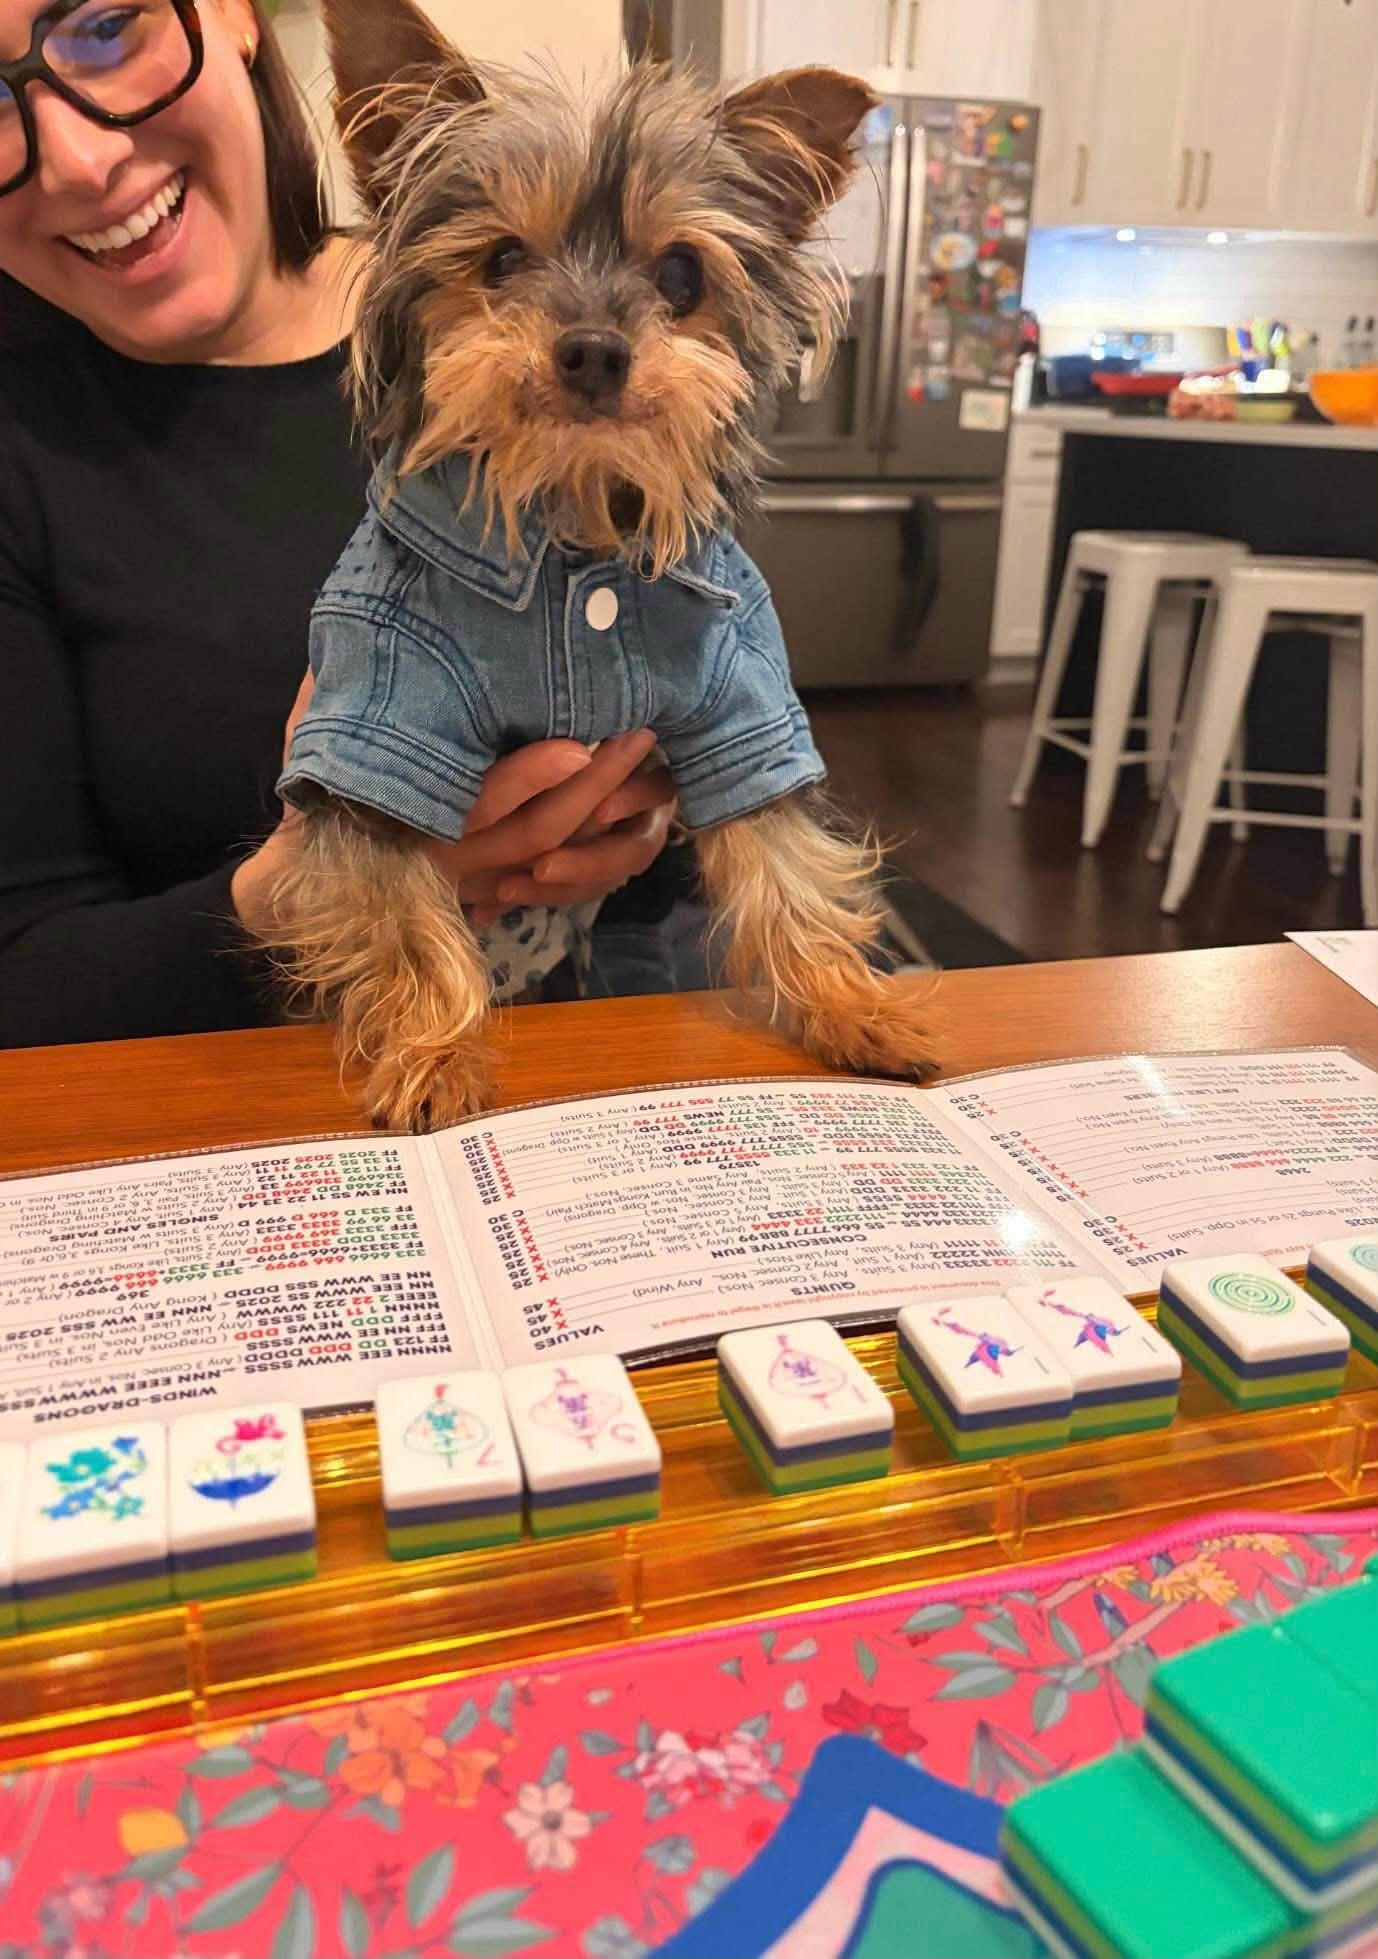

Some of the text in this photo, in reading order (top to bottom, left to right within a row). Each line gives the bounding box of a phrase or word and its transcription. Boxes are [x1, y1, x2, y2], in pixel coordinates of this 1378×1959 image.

[718, 1161, 760, 1170] 13579
[488, 1214, 508, 1224] 30
[1083, 1218, 1103, 1228] 30
[49, 1214, 219, 1242] SINGLES AND PAIRS
[492, 1223, 512, 1233] 30
[1093, 1227, 1114, 1237] 30
[496, 1231, 515, 1242] 25
[1103, 1236, 1122, 1246] 25
[499, 1240, 518, 1251] 25
[711, 1234, 867, 1258] CONSECUTIVE RUN
[1112, 1245, 1134, 1255] 25
[502, 1249, 521, 1260] 25
[1127, 1248, 1188, 1266] VALUES
[506, 1258, 525, 1270] 25
[509, 1268, 529, 1280] 25
[224, 1271, 431, 1298] NN EE WWW SSS DDDD
[512, 1278, 532, 1289] 25
[790, 1281, 856, 1295] QUINTS
[116, 1290, 149, 1301] 369
[236, 1281, 434, 1308] NN EEE WWW SS 2025
[395, 1291, 437, 1301] EEEE
[314, 1299, 346, 1309] 222
[352, 1296, 373, 1305] 22
[237, 1304, 307, 1318] WWWW
[523, 1304, 543, 1314] 45
[527, 1314, 547, 1325] 45
[234, 1312, 443, 1341] FFFF DDD NEWS DDD
[530, 1326, 551, 1337] 40
[246, 1323, 446, 1351] FFF NN EE WWW SSSS
[534, 1325, 604, 1350] VALUES
[244, 1334, 449, 1362] FF 123 DD DDD DDDD
[244, 1344, 452, 1374] NNNN EEE WWW SSSS
[34, 1386, 217, 1423] WINDS-DRAGONS
